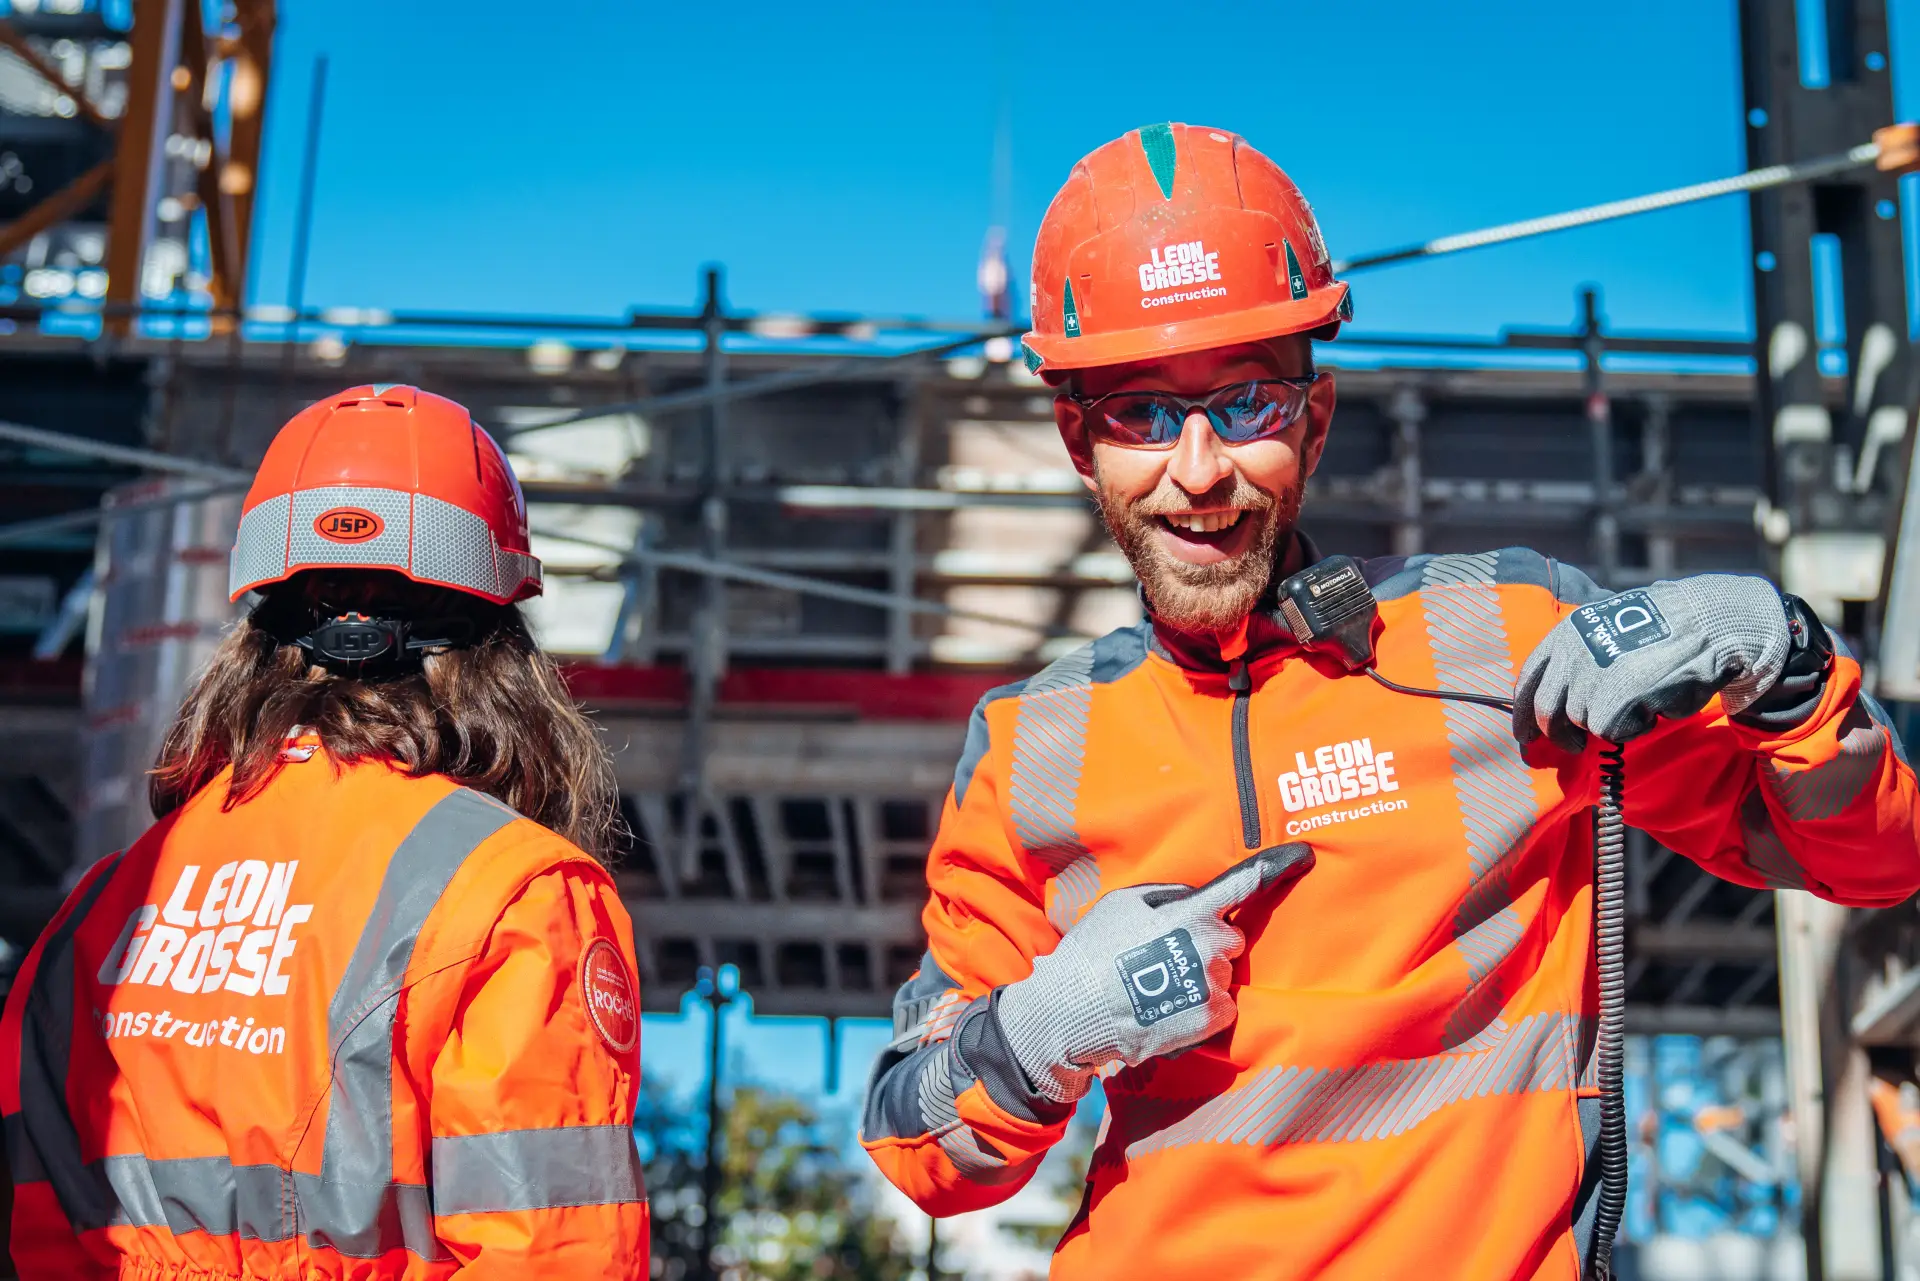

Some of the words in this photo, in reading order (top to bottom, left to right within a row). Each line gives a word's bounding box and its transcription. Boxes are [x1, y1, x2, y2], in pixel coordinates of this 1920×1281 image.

[1138, 252, 1221, 292] GROSSE
[1151, 240, 1205, 268] LEON
[1141, 286, 1227, 308] Construction
[327, 518, 369, 533] JSP
[1320, 571, 1352, 590] MOTOROLA
[1580, 607, 1601, 624] 615
[1614, 605, 1653, 633] D
[328, 632, 380, 653] JSP
[1593, 622, 1621, 658] MAPA
[1295, 737, 1375, 778] LEON
[1277, 751, 1400, 813] GROSSE
[1285, 799, 1408, 836] Construction
[161, 859, 300, 928] LEON
[96, 903, 315, 997] GROSSE
[1131, 961, 1170, 997] D
[1164, 936, 1190, 977] MAPA
[1183, 979, 1202, 1003] 615
[1166, 958, 1182, 987] KRYTECH
